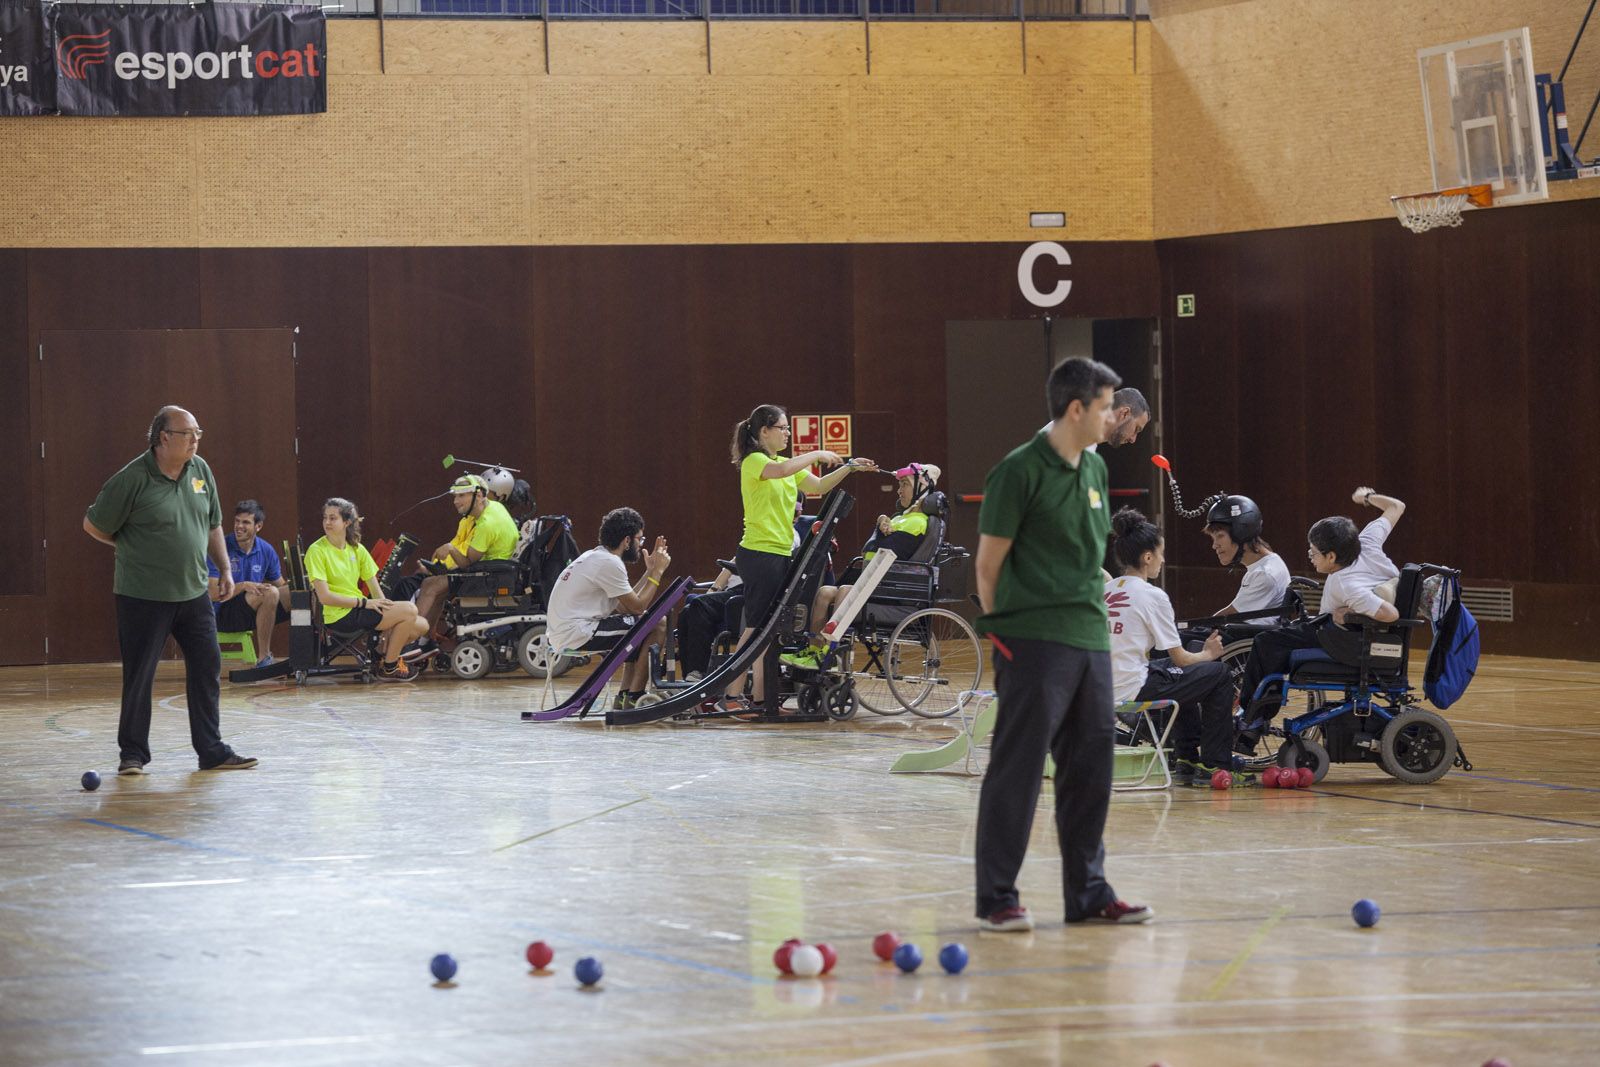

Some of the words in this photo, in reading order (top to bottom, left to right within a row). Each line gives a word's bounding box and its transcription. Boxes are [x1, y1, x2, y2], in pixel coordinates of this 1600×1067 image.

[0, 65, 28, 87] ya
[115, 43, 320, 89] esportcat
[1018, 241, 1072, 307] C
